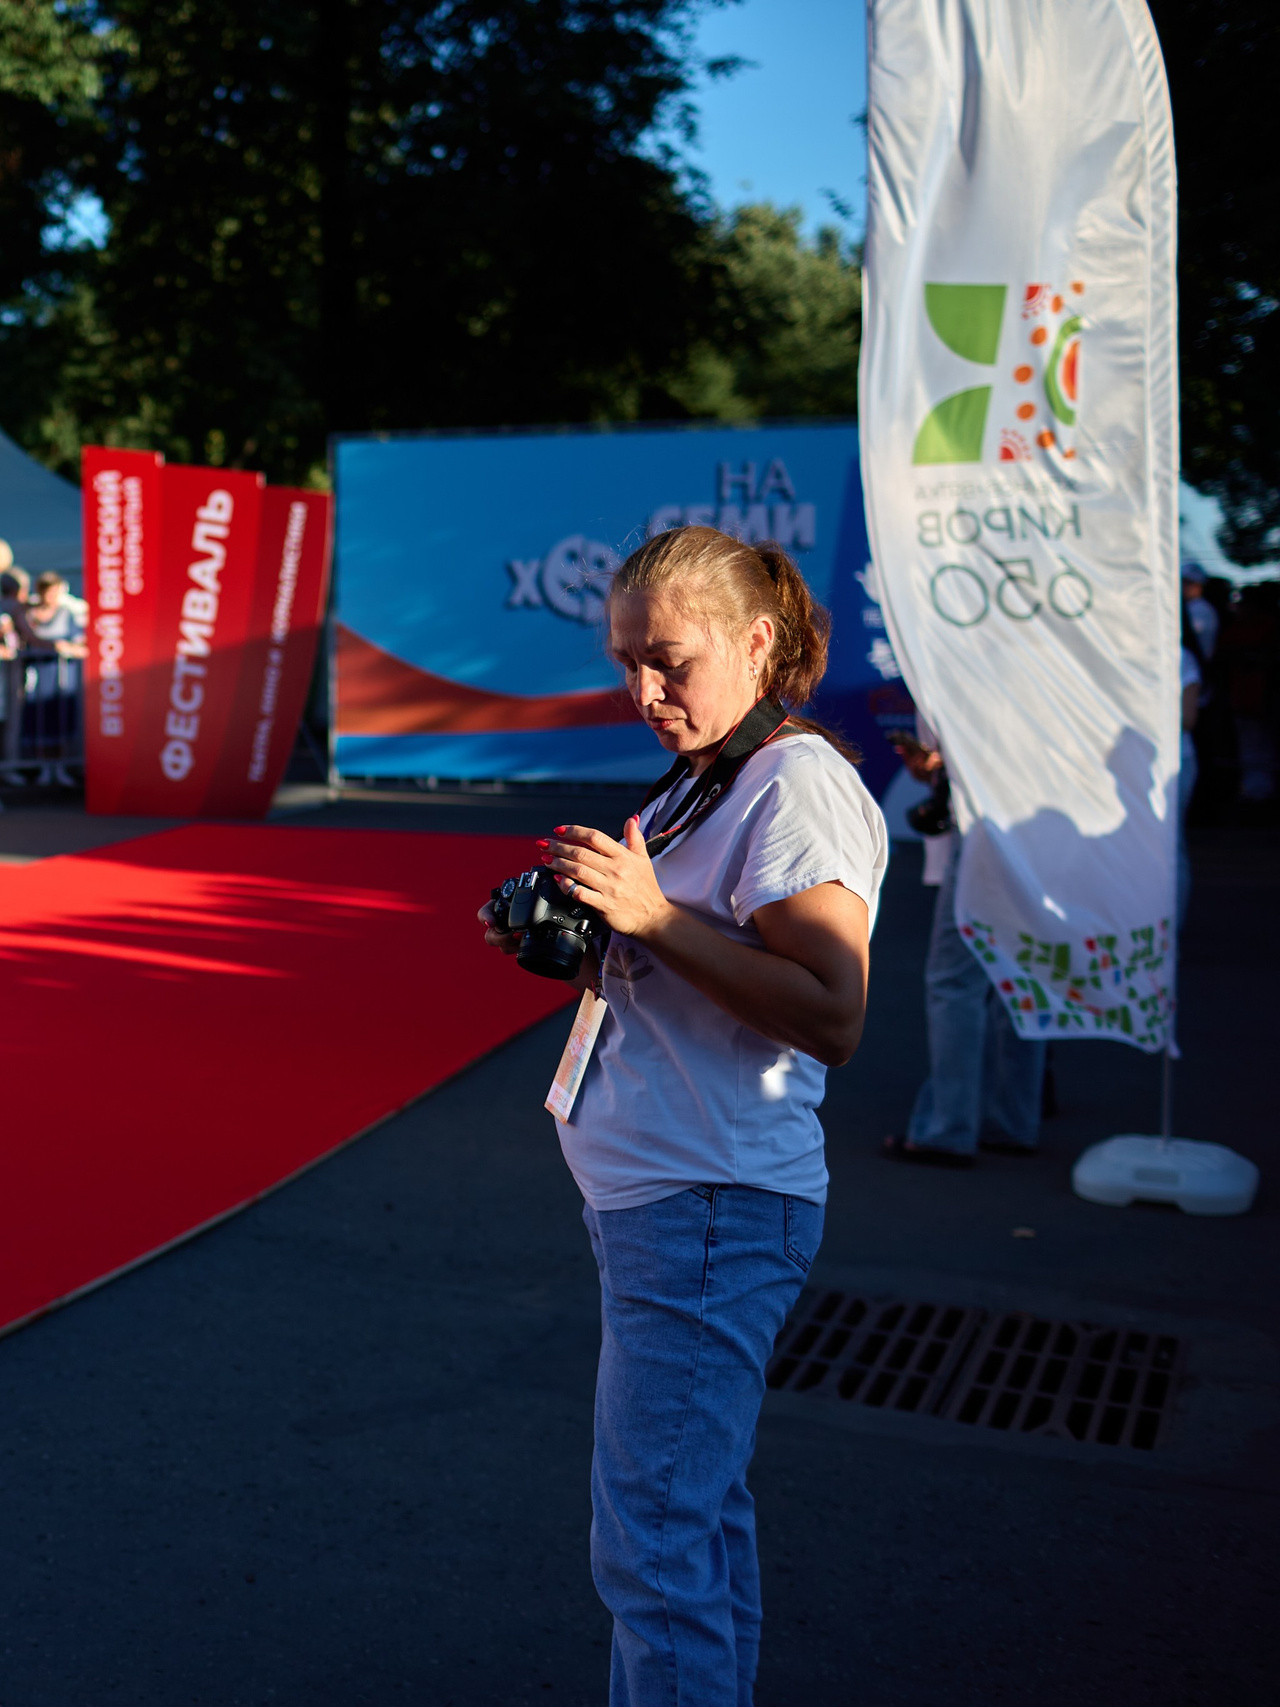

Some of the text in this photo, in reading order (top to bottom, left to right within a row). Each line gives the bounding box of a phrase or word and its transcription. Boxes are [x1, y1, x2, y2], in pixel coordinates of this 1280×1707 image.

[92, 469, 124, 737] ВТОРОЙ ВЯТСКИЙ
[721, 457, 797, 501] НА
[160, 488, 234, 781] ФЕСТИВАЛЬ
